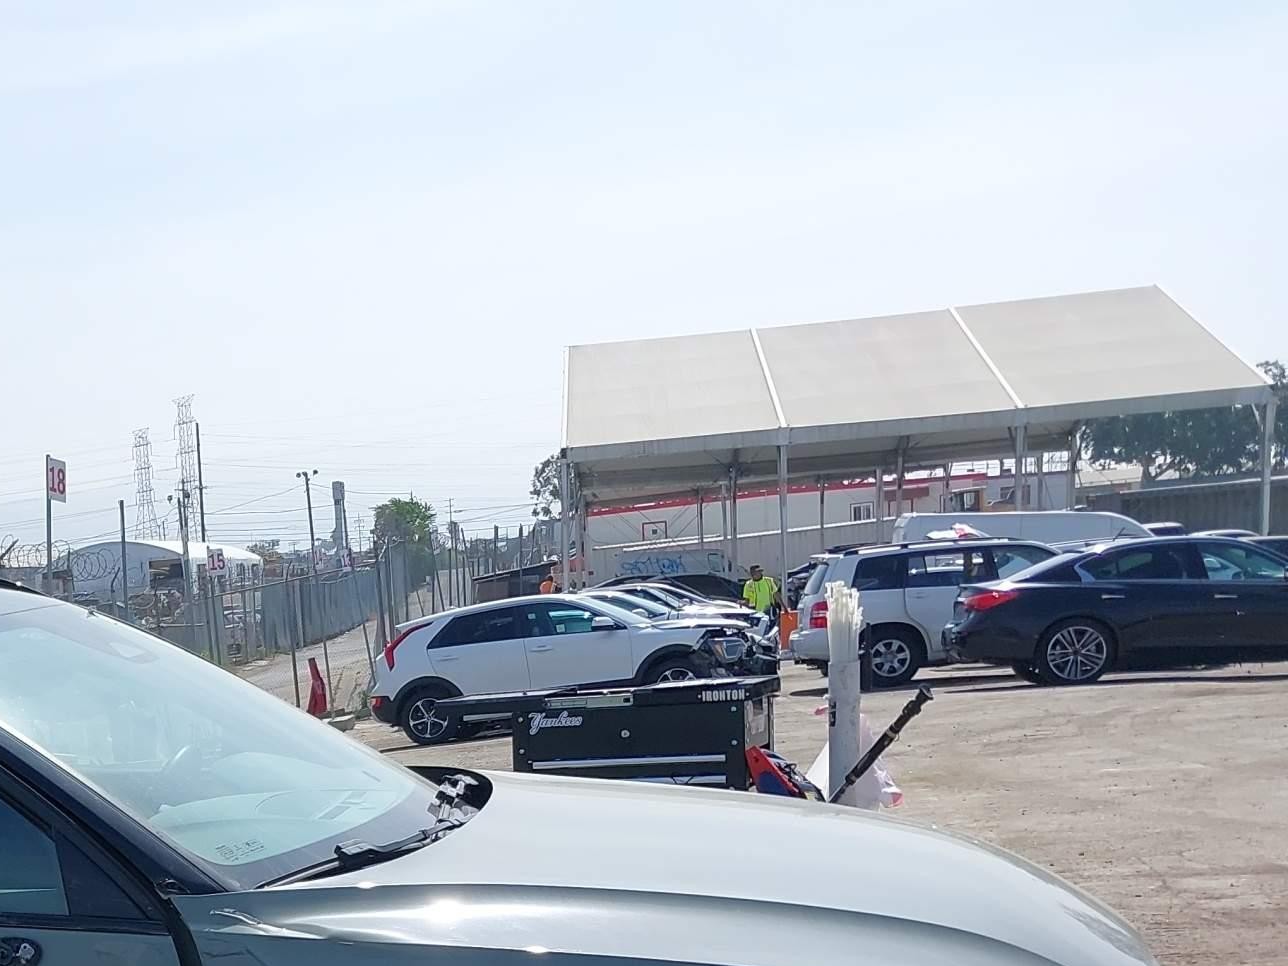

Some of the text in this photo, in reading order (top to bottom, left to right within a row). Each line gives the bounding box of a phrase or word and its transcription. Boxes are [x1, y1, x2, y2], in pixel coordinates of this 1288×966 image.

[49, 466, 66, 495] 18
[208, 553, 225, 570] 15
[702, 688, 745, 702] IRONTON
[528, 710, 583, 735] Yankees
